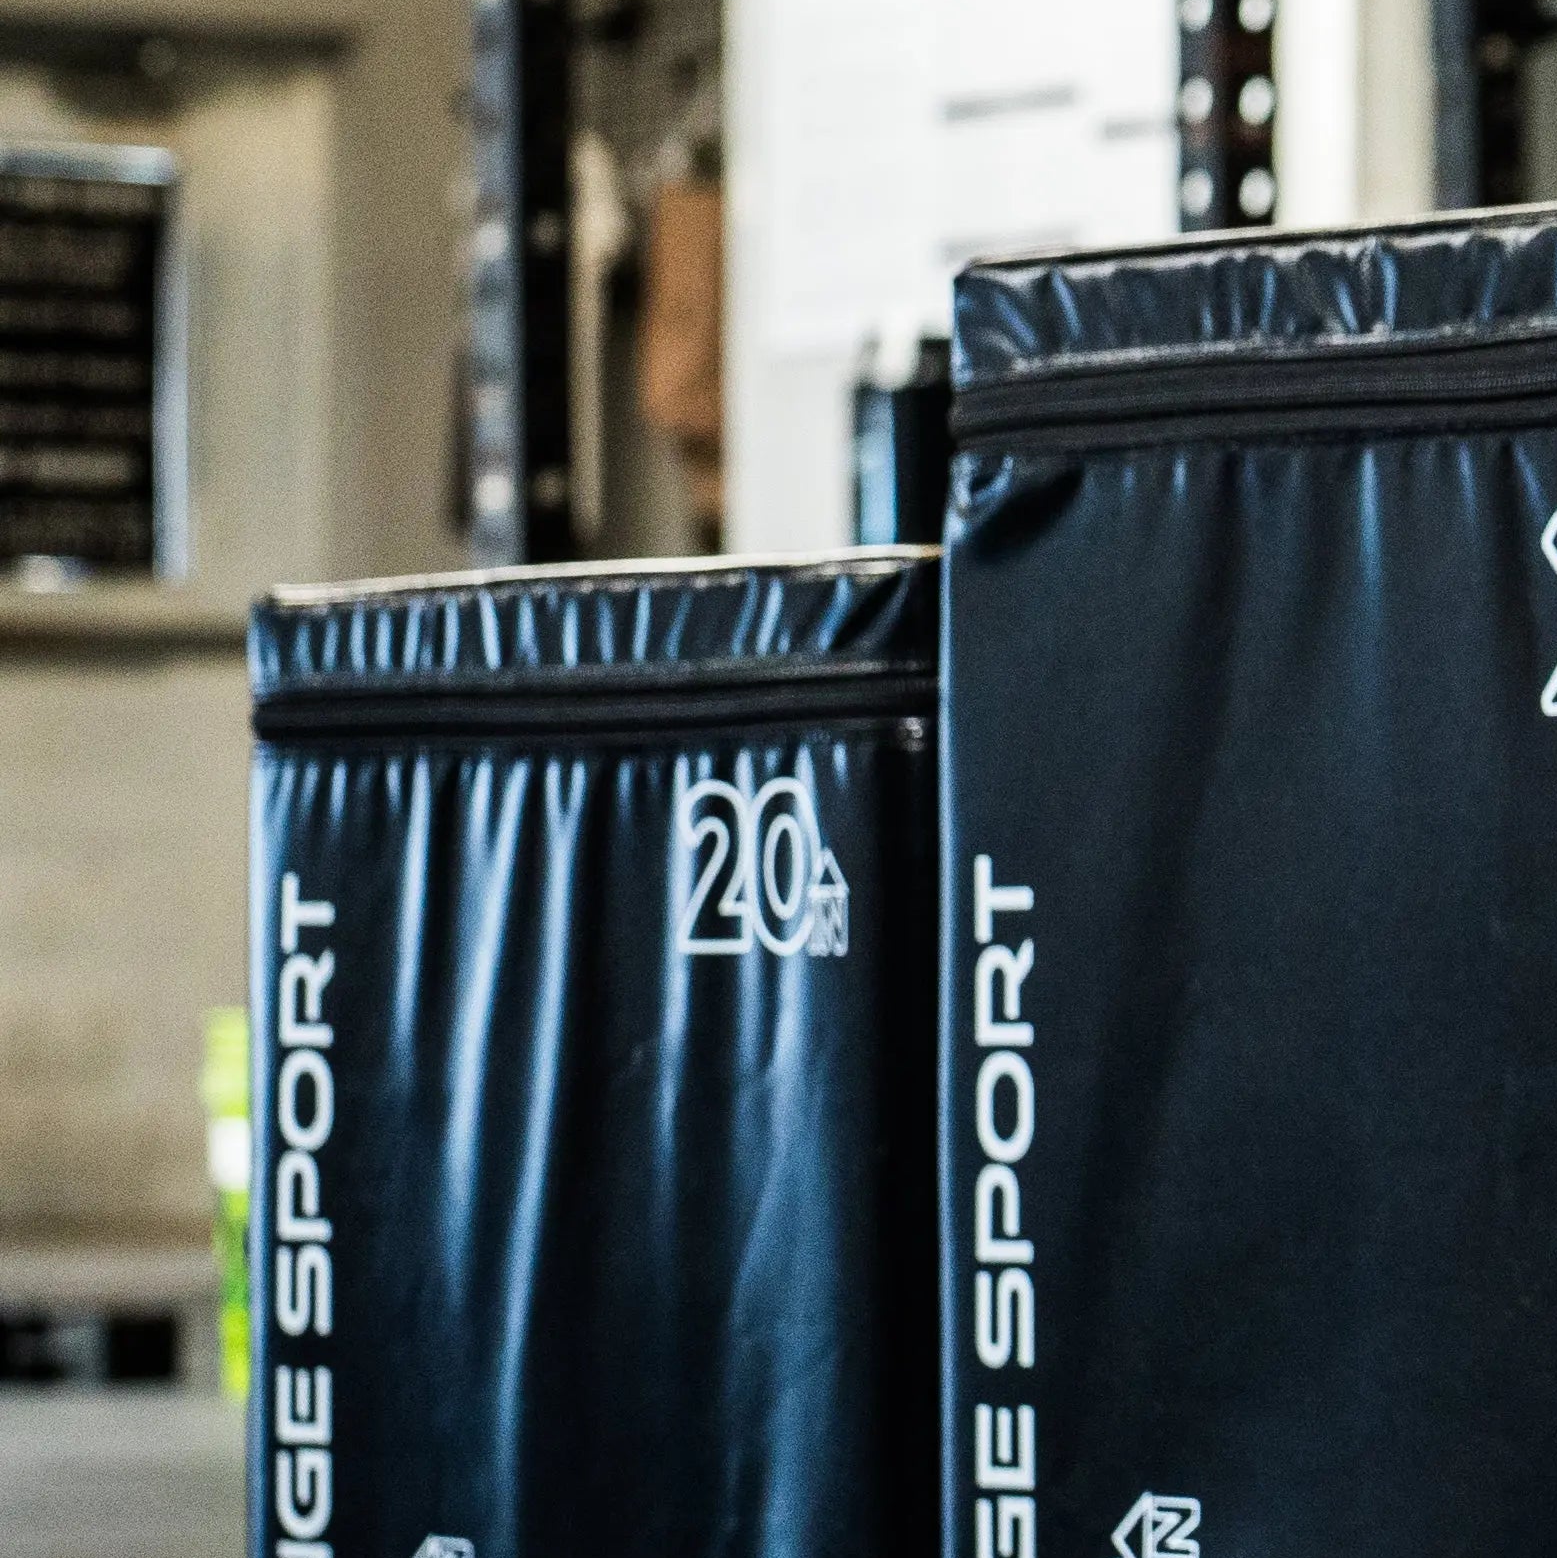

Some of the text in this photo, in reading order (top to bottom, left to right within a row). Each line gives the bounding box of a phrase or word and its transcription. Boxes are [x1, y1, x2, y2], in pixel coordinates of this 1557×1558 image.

[677, 776, 823, 957] 20
[275, 873, 336, 1338] SPORT
[974, 853, 1034, 1370] SPORT
